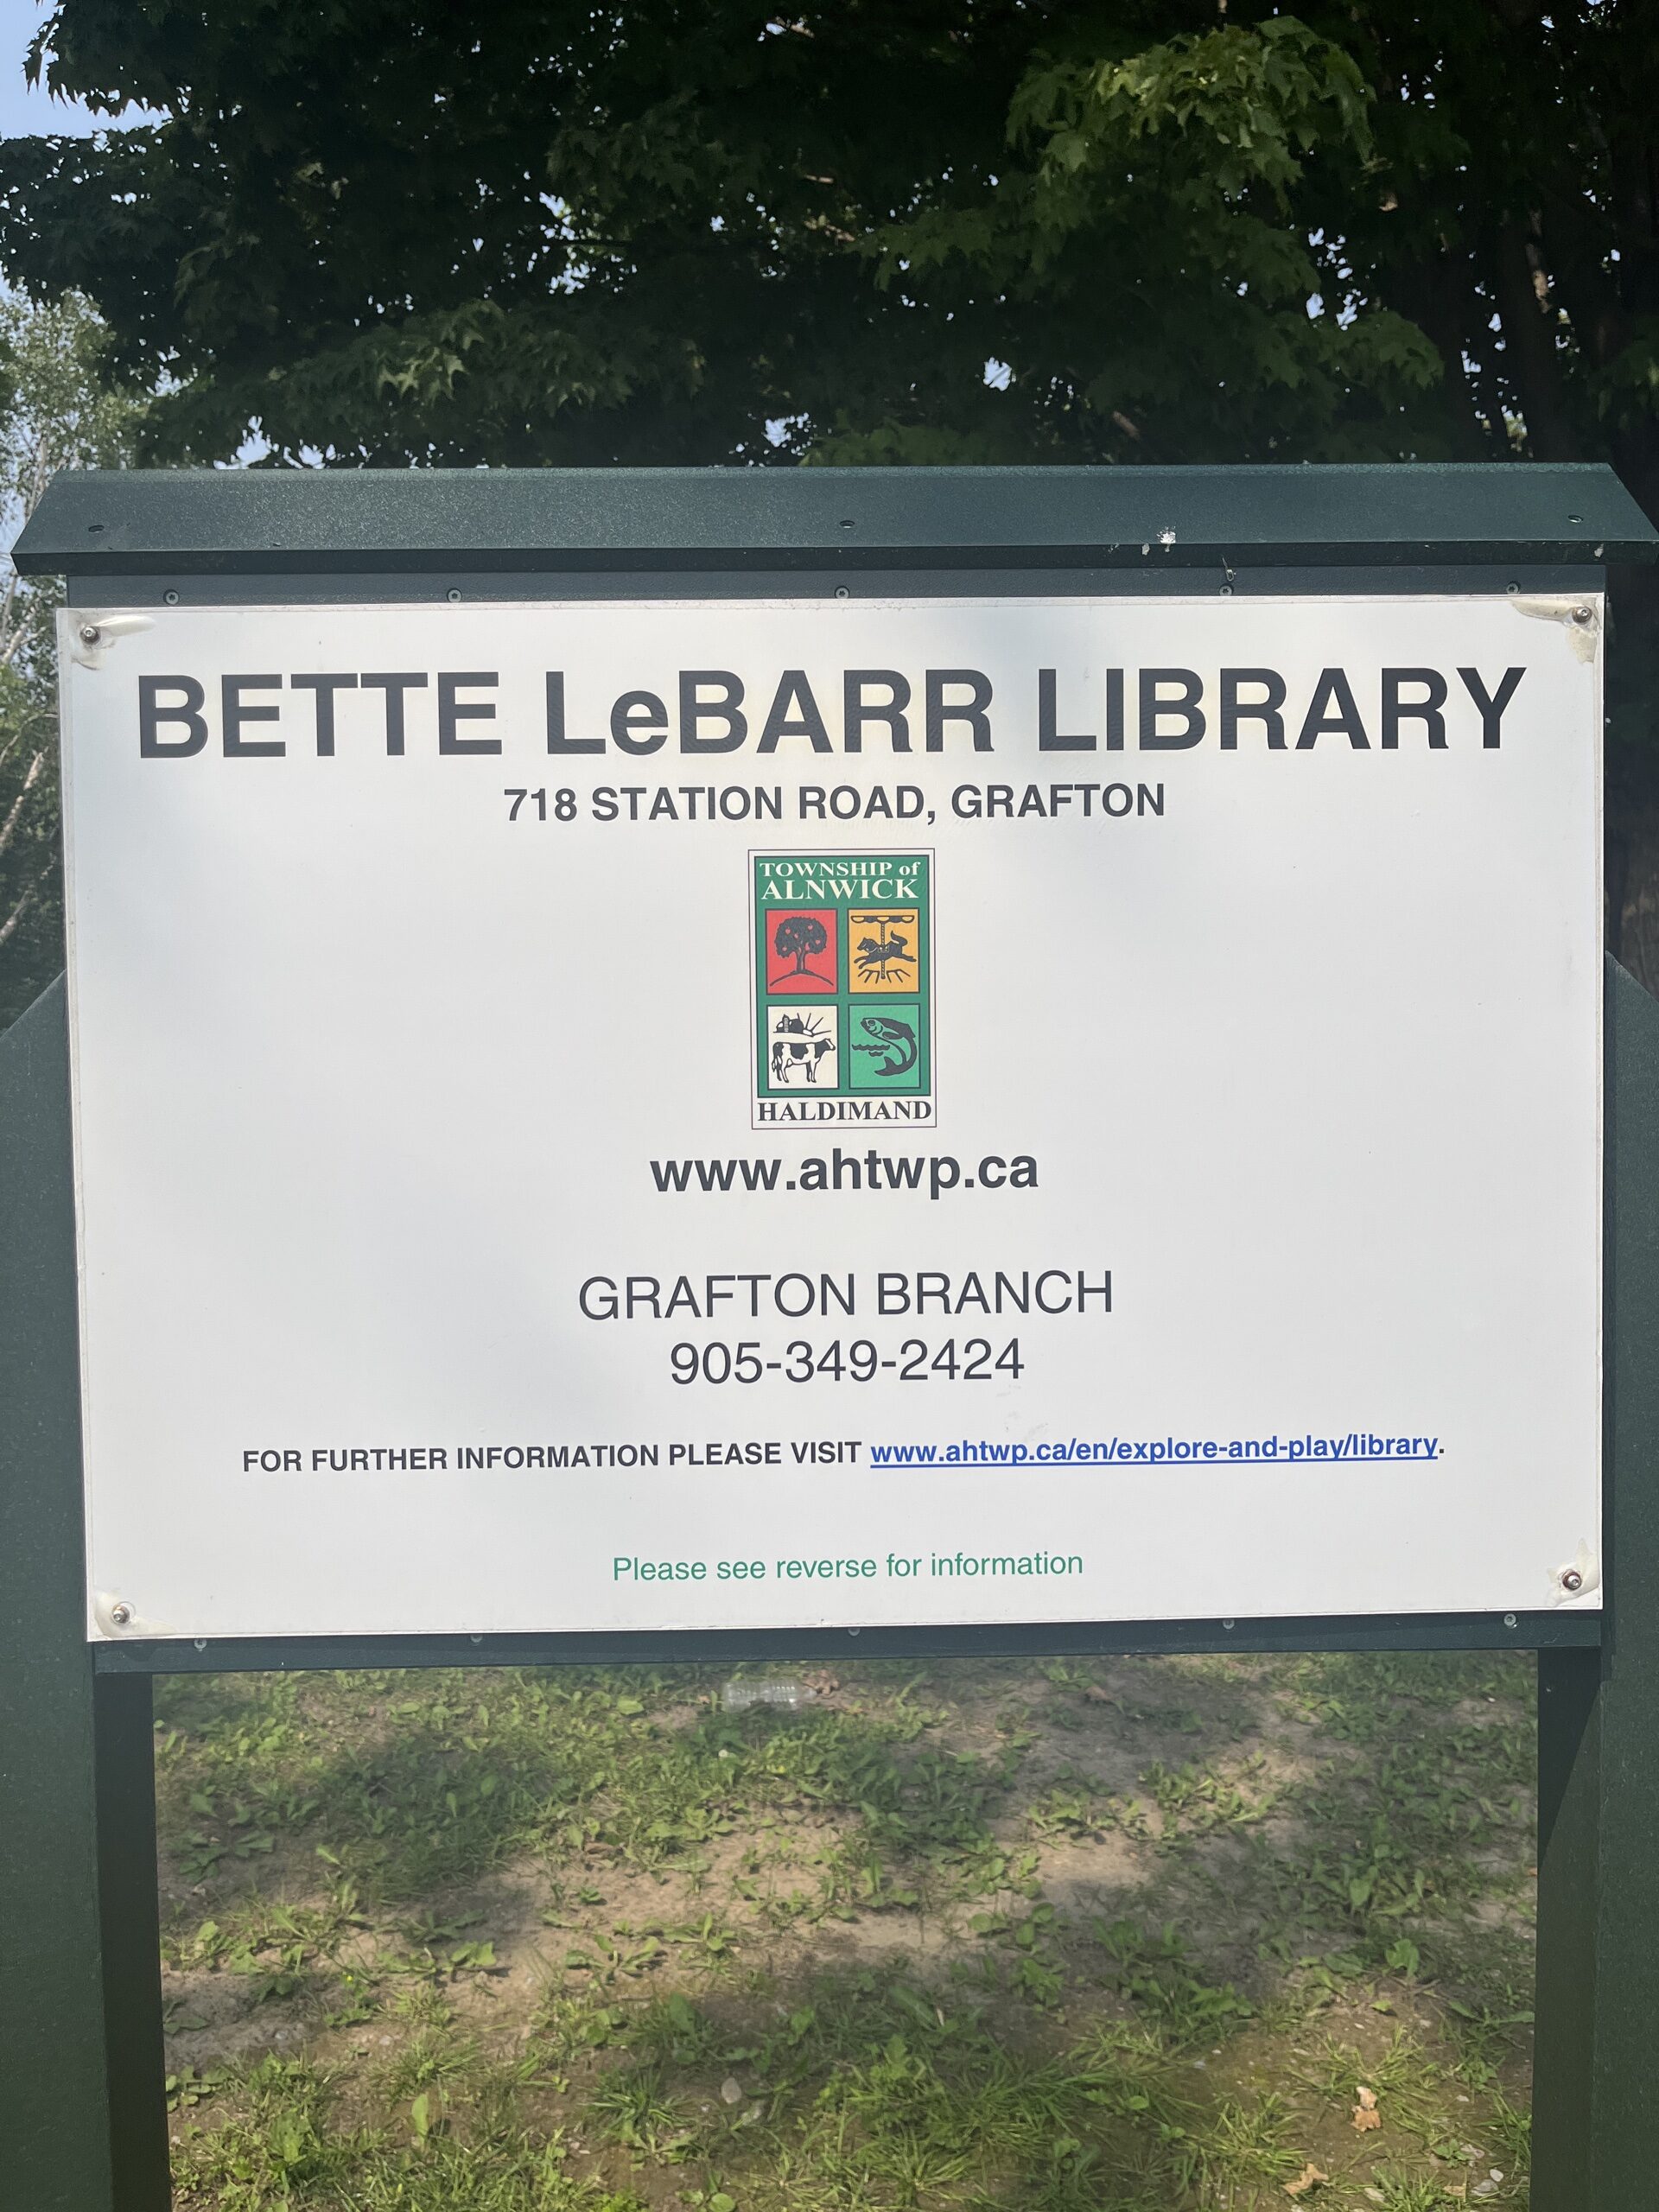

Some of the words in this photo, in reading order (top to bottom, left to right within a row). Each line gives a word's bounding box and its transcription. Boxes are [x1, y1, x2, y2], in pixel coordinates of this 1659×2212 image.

[138, 672, 502, 759] BETTE
[546, 670, 995, 755] LeBARR
[1039, 667, 1527, 751] LIBRARY
[505, 788, 577, 821] 718
[592, 786, 781, 821] STATION
[799, 785, 935, 825] ROAD,
[952, 783, 1164, 818] GRAFTON
[759, 861, 893, 878] TOWNSHIP
[899, 861, 922, 876] of
[760, 878, 919, 900] ALNWICK
[757, 1100, 932, 1122] HALDIMAND
[650, 1148, 1039, 1200] www.ahtwp.ca
[580, 1274, 855, 1320] GRAFTON
[878, 1270, 1111, 1314] BRANCH
[671, 1338, 1024, 1384] 905-349-2424
[244, 1450, 302, 1471] FOR
[313, 1448, 447, 1471] FURTHER
[458, 1445, 658, 1469] INFORMATION
[670, 1442, 781, 1465] PLEASE
[791, 1441, 861, 1464] VISIT
[870, 1433, 1446, 1468] www.ahtwp.ca/en/explore-and-play/library.
[614, 1557, 706, 1580] Please
[717, 1561, 766, 1580] see
[778, 1560, 876, 1579] reverse
[887, 1554, 922, 1576] for
[932, 1551, 1082, 1576] information
